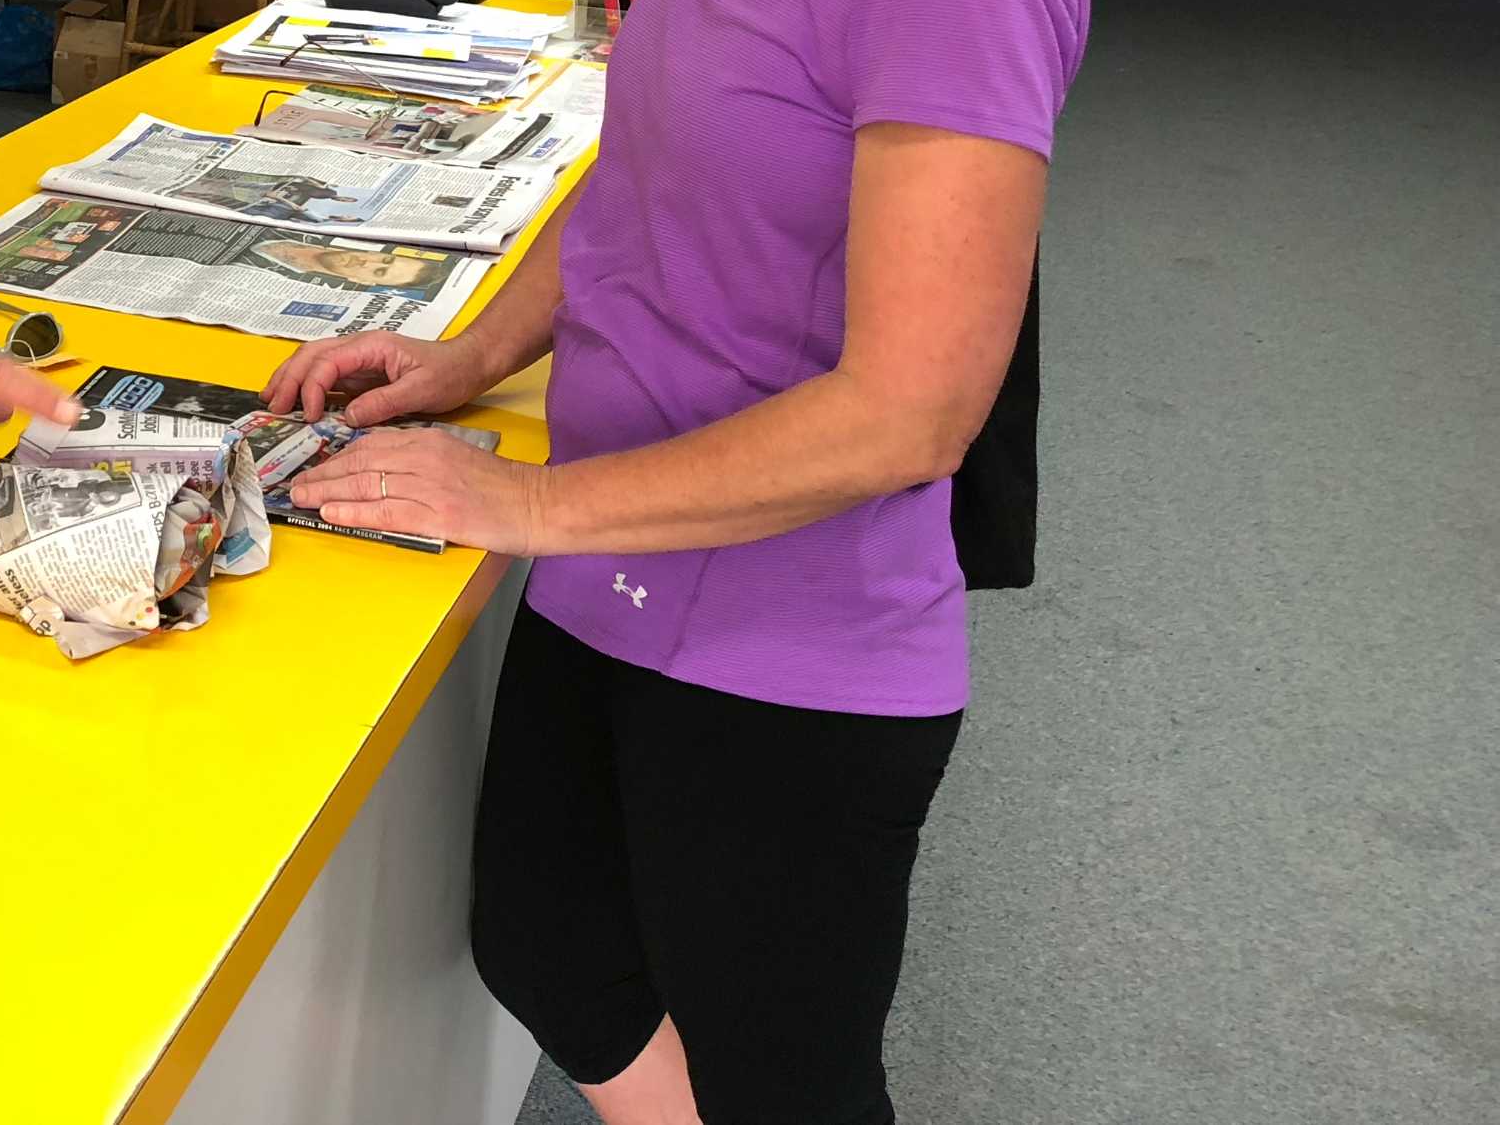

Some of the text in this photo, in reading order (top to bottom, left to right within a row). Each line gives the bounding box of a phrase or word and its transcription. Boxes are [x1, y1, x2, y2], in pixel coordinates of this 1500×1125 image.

[488, 175, 521, 197] Fearless
[356, 293, 393, 320] positive
[380, 321, 403, 332] cre
[287, 516, 316, 529] OFFICIAL
[352, 528, 384, 541] PROGRAM
